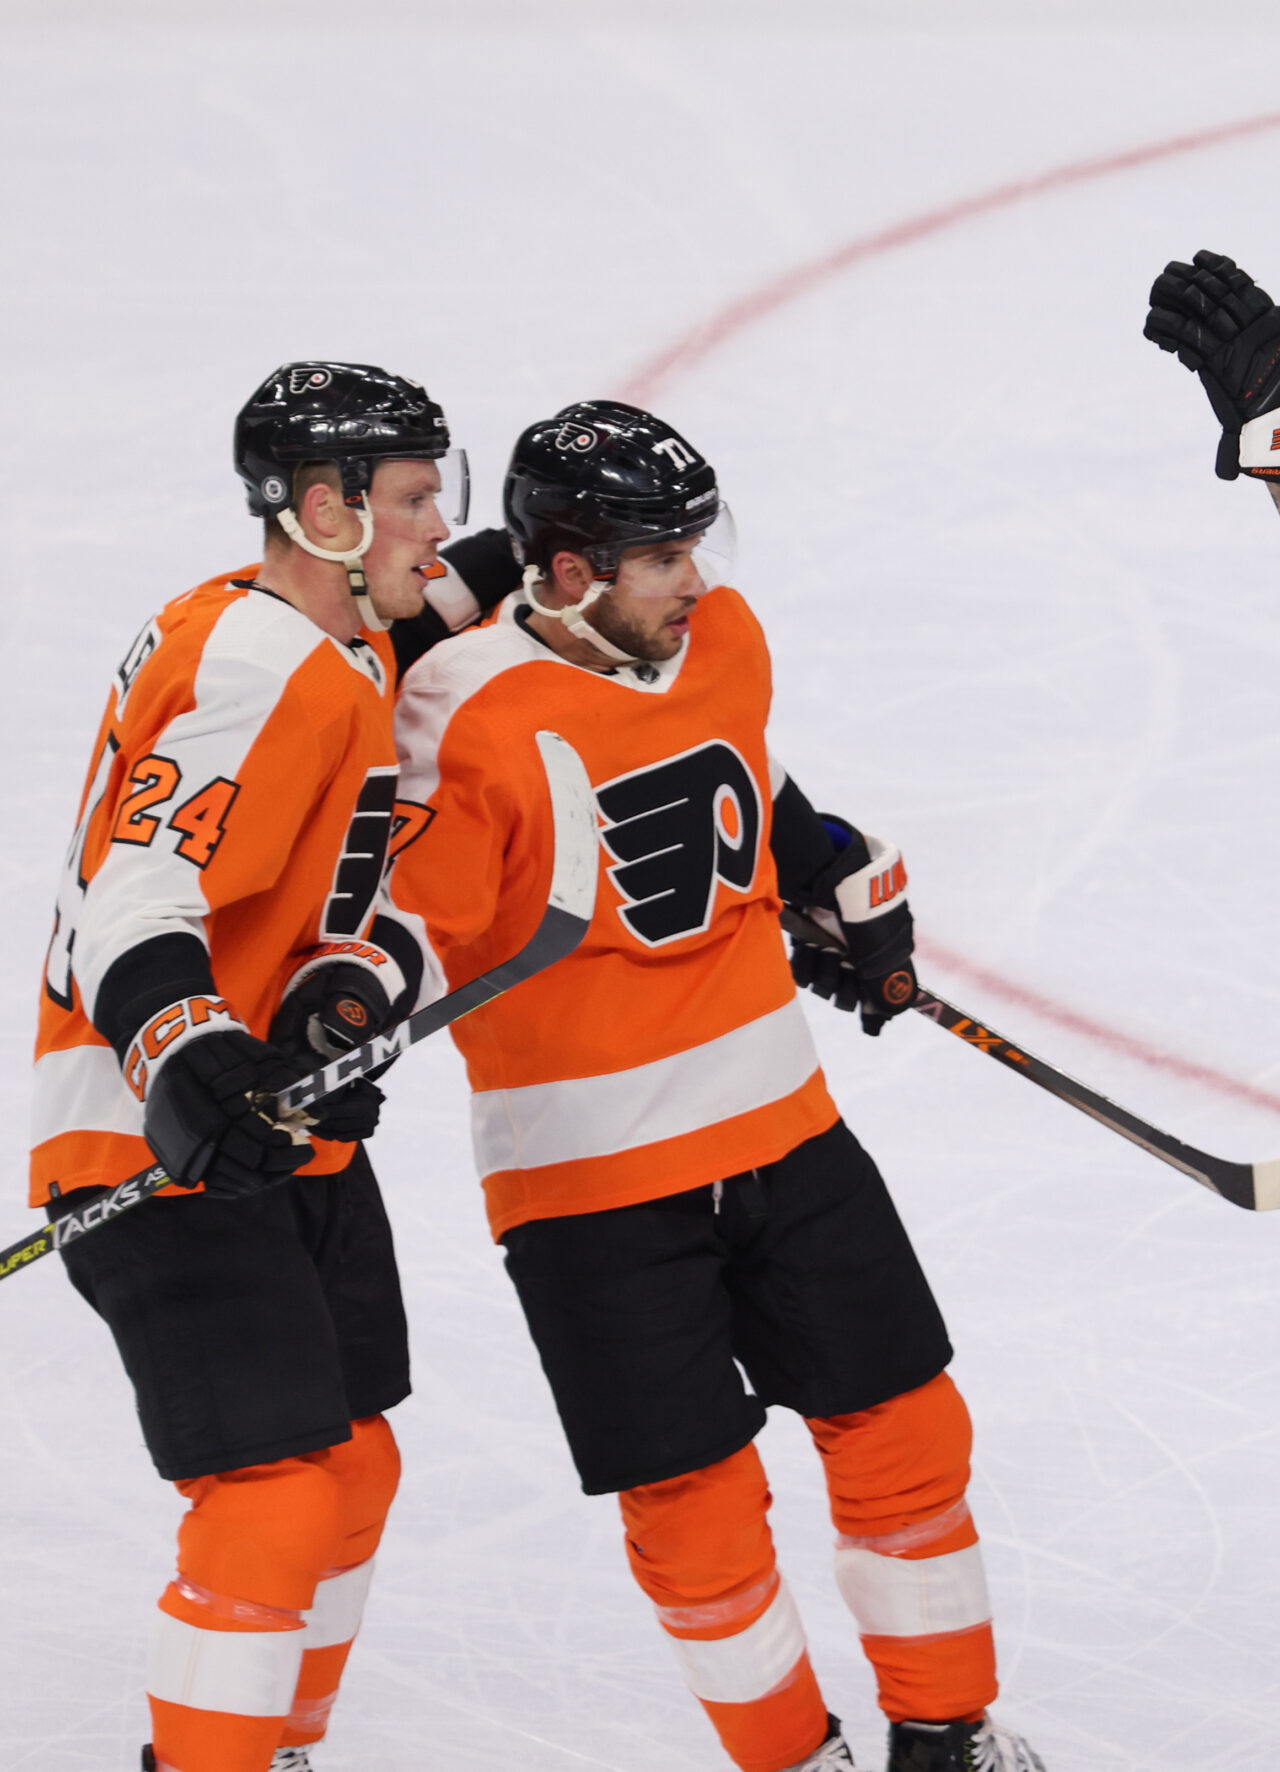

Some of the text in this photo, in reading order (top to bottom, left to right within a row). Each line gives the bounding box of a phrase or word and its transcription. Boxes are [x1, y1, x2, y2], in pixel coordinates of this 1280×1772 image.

[651, 437, 697, 469] 77
[110, 753, 242, 871] 24
[125, 997, 243, 1103] CCM
[283, 1019, 412, 1110] CCM
[53, 1181, 141, 1250] TACKS
